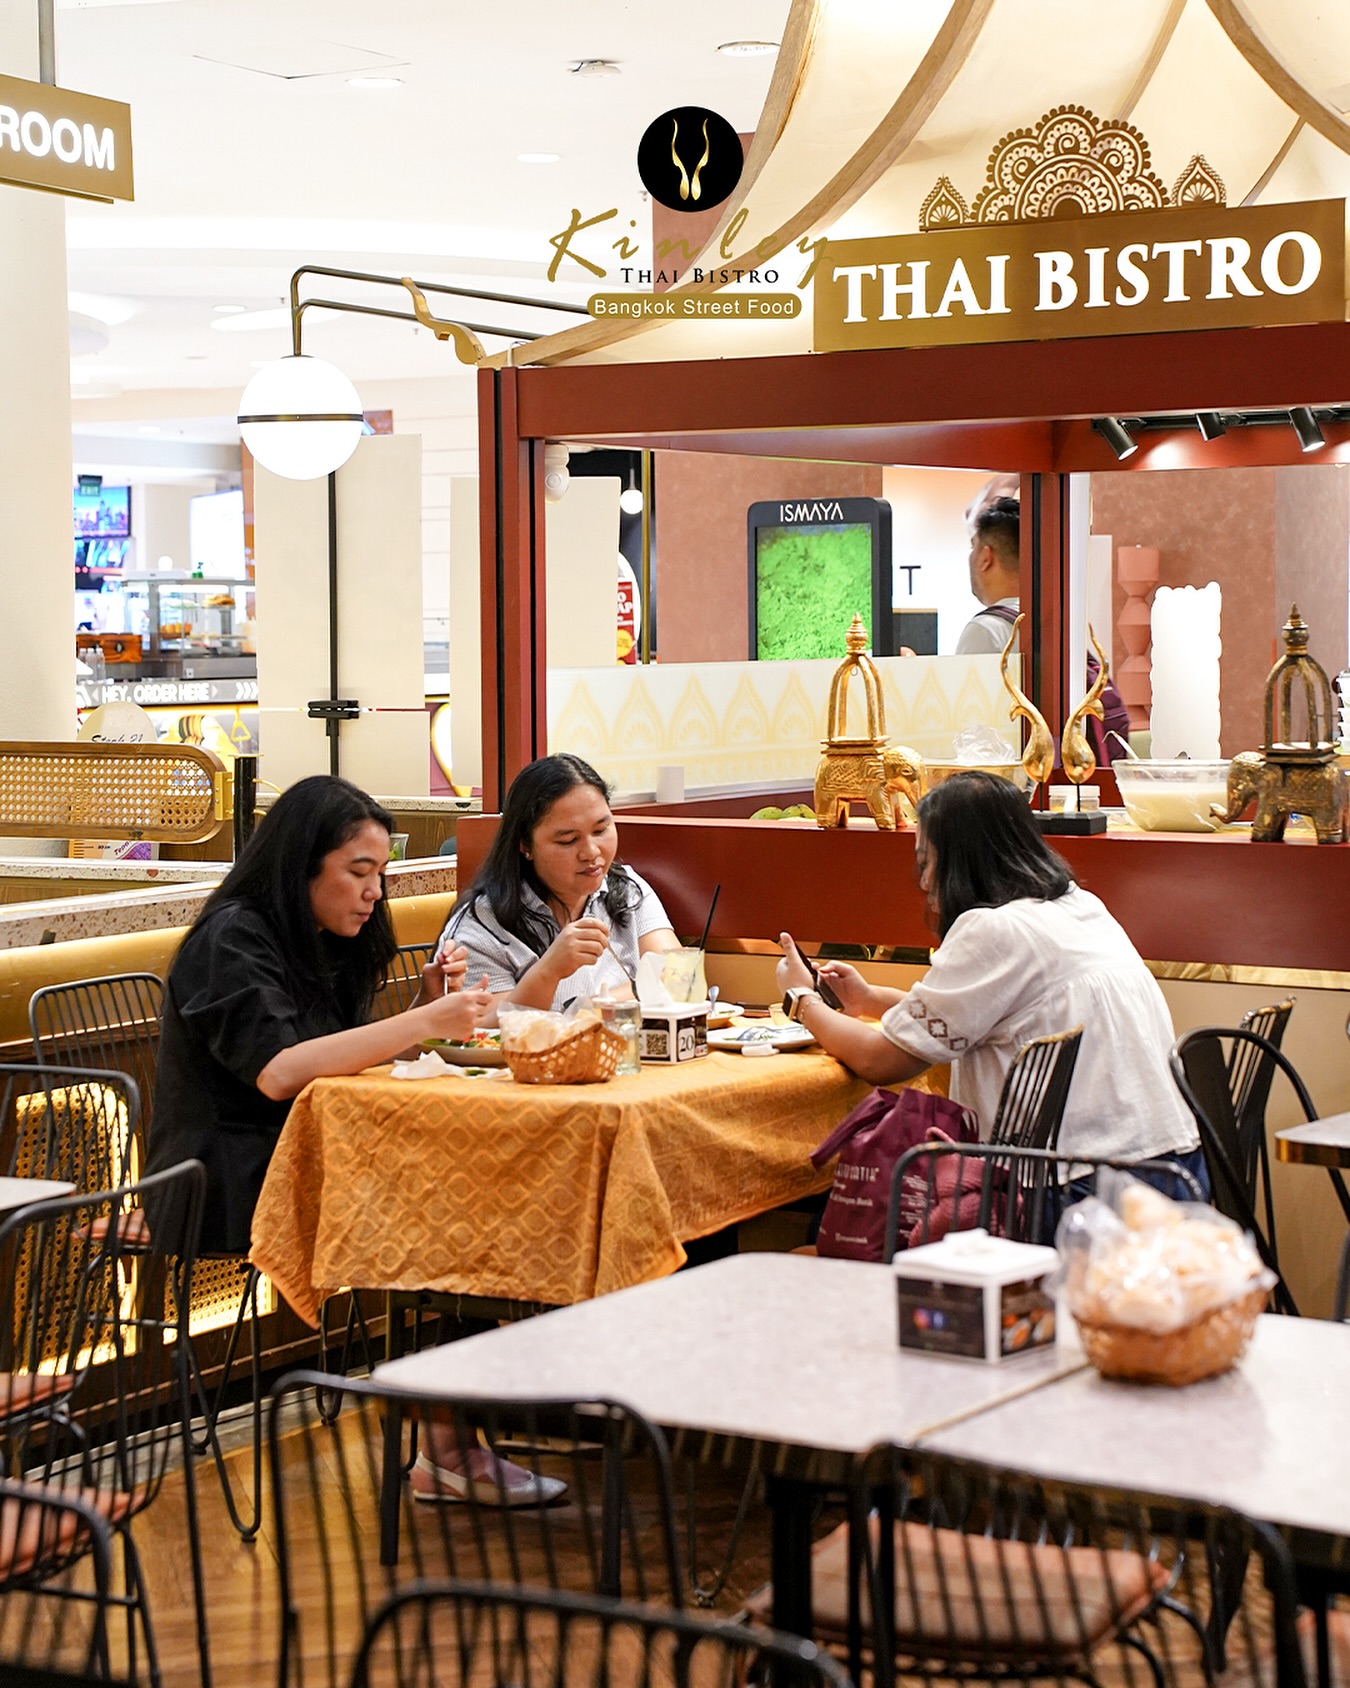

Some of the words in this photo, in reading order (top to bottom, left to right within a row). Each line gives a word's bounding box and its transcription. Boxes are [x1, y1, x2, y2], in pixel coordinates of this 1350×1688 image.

[0, 105, 115, 172] ROOM
[832, 254, 1012, 324] THAI
[1033, 230, 1323, 312] BISTRO
[779, 501, 845, 523] ISMAYA
[133, 683, 178, 703] ORDER
[178, 682, 210, 701] HERE
